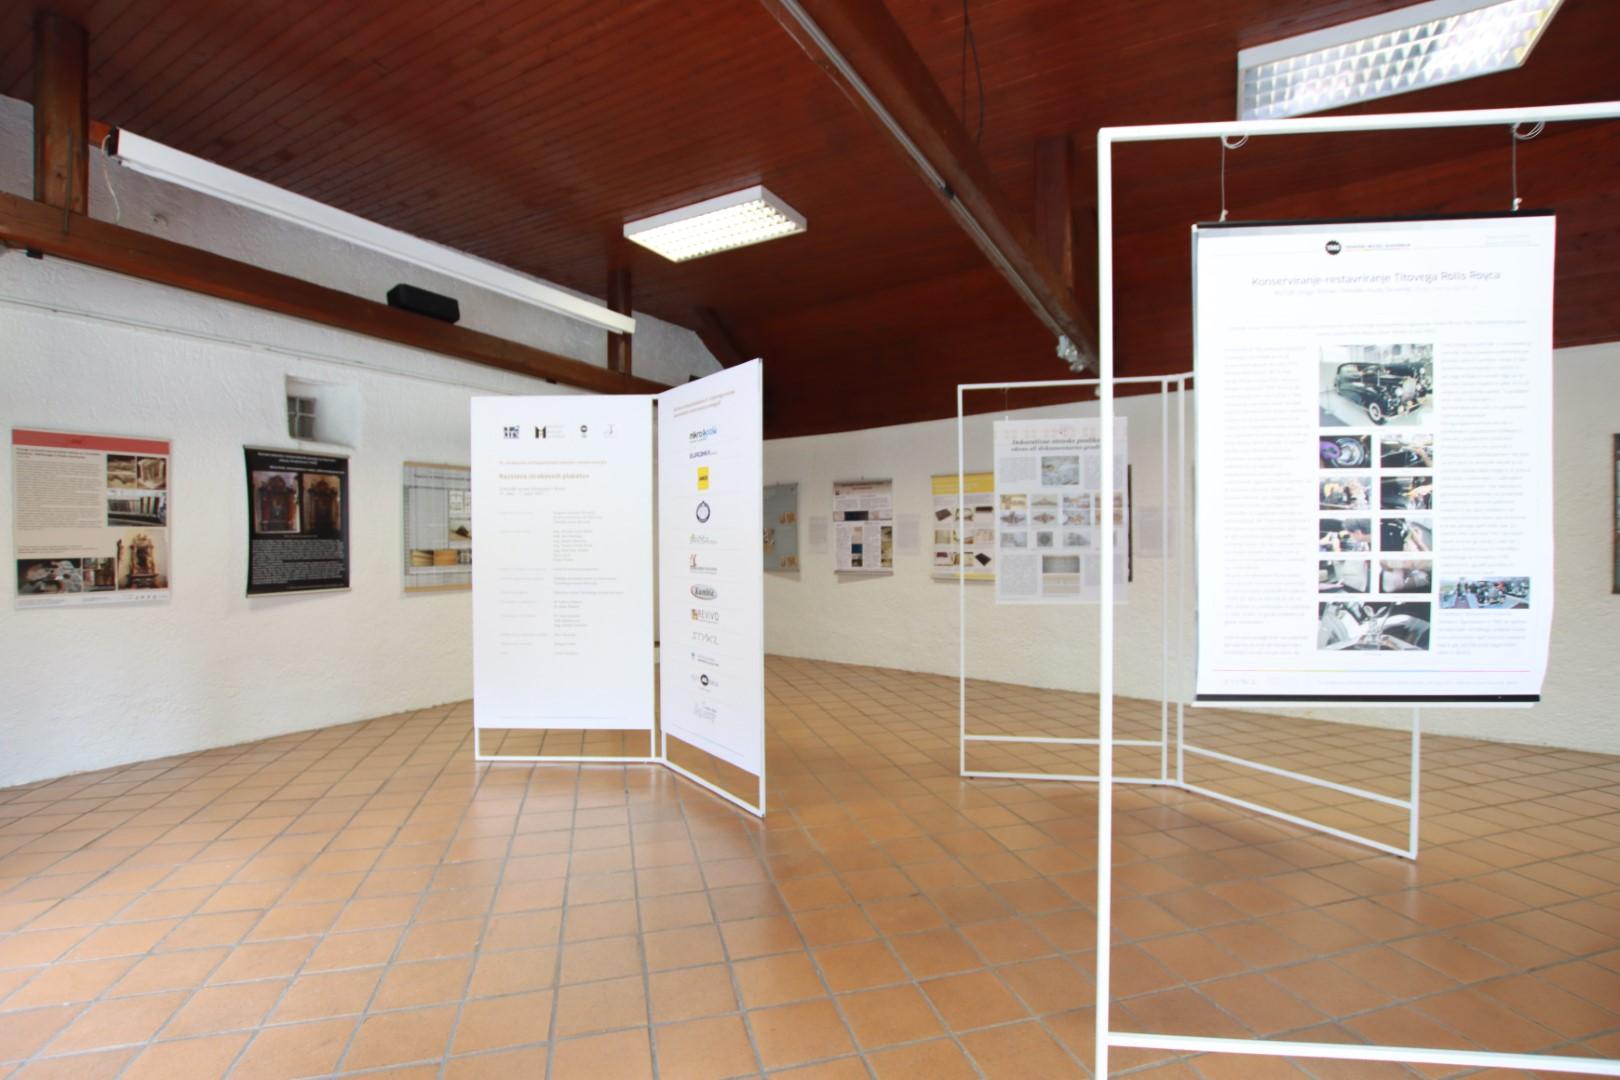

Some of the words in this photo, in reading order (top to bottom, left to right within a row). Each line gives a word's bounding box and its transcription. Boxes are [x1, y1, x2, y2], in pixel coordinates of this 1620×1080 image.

[1394, 271, 1438, 284] Titovega
[1440, 271, 1466, 281] Rolls
[1469, 270, 1501, 283] Royca
